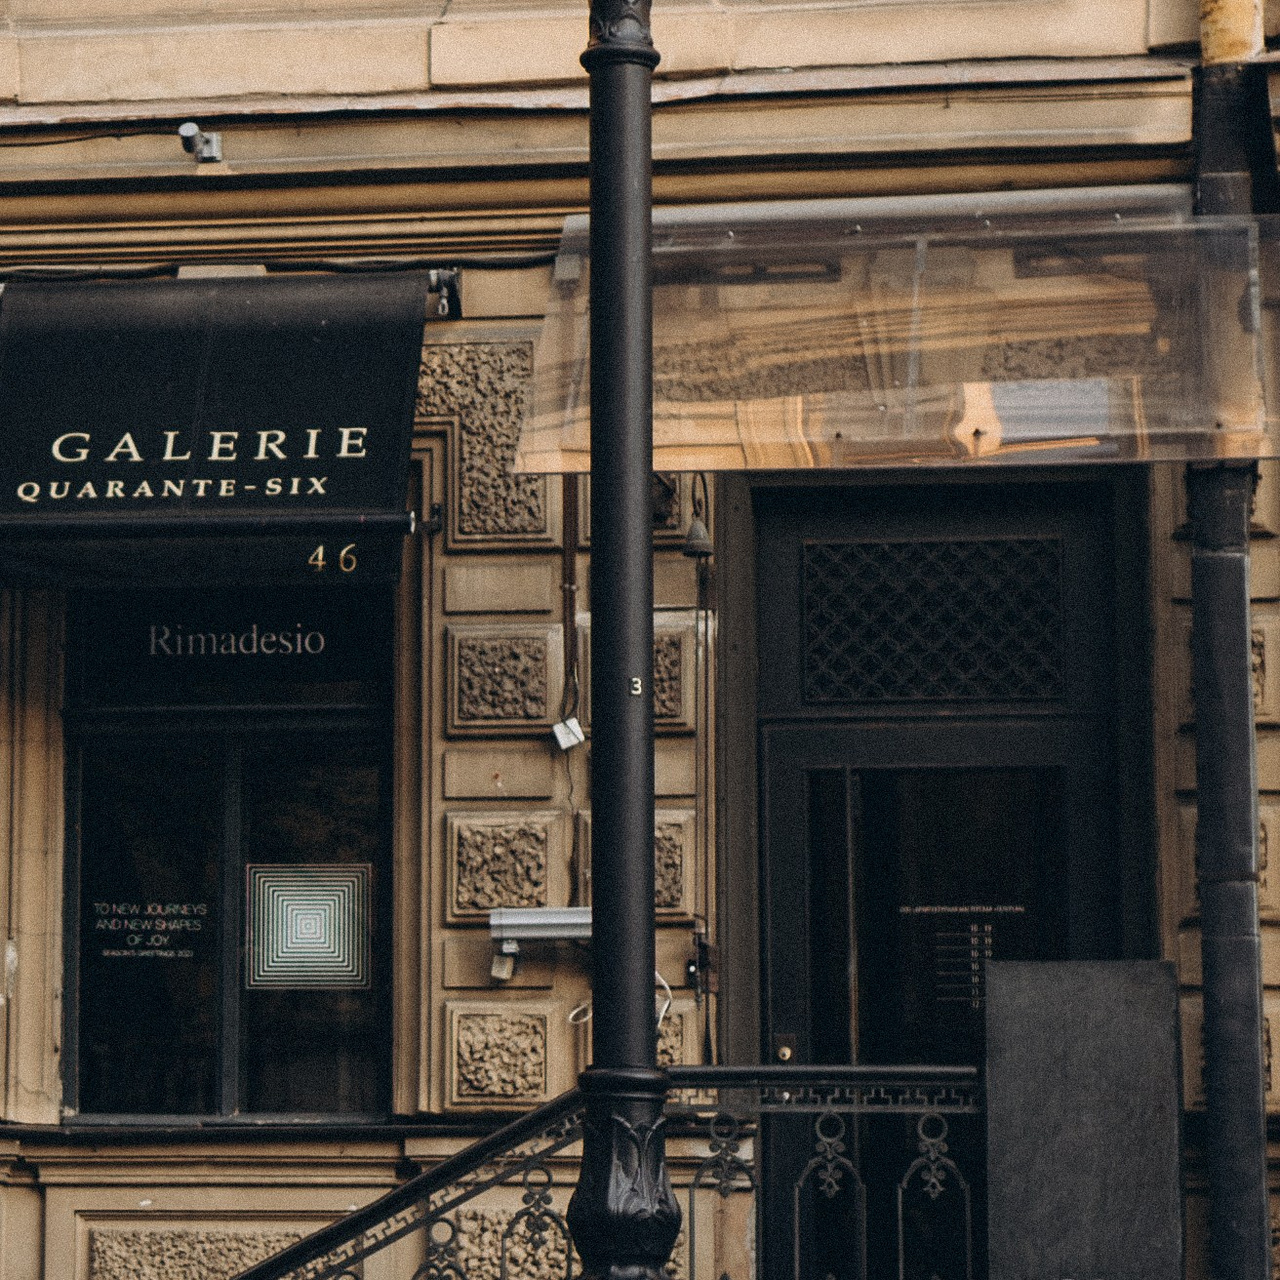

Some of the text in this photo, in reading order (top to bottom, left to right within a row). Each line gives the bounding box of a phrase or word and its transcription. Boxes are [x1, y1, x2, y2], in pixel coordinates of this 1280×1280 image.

[51, 427, 369, 463] GALERIE
[16, 477, 328, 503] QUARANTE-SIX
[148, 622, 326, 656] Rimadesio
[630, 677, 643, 696] 3
[112, 902, 141, 915] NEW
[95, 918, 122, 930] AND
[124, 918, 153, 930] NEW
[145, 934, 170, 946] JOY
